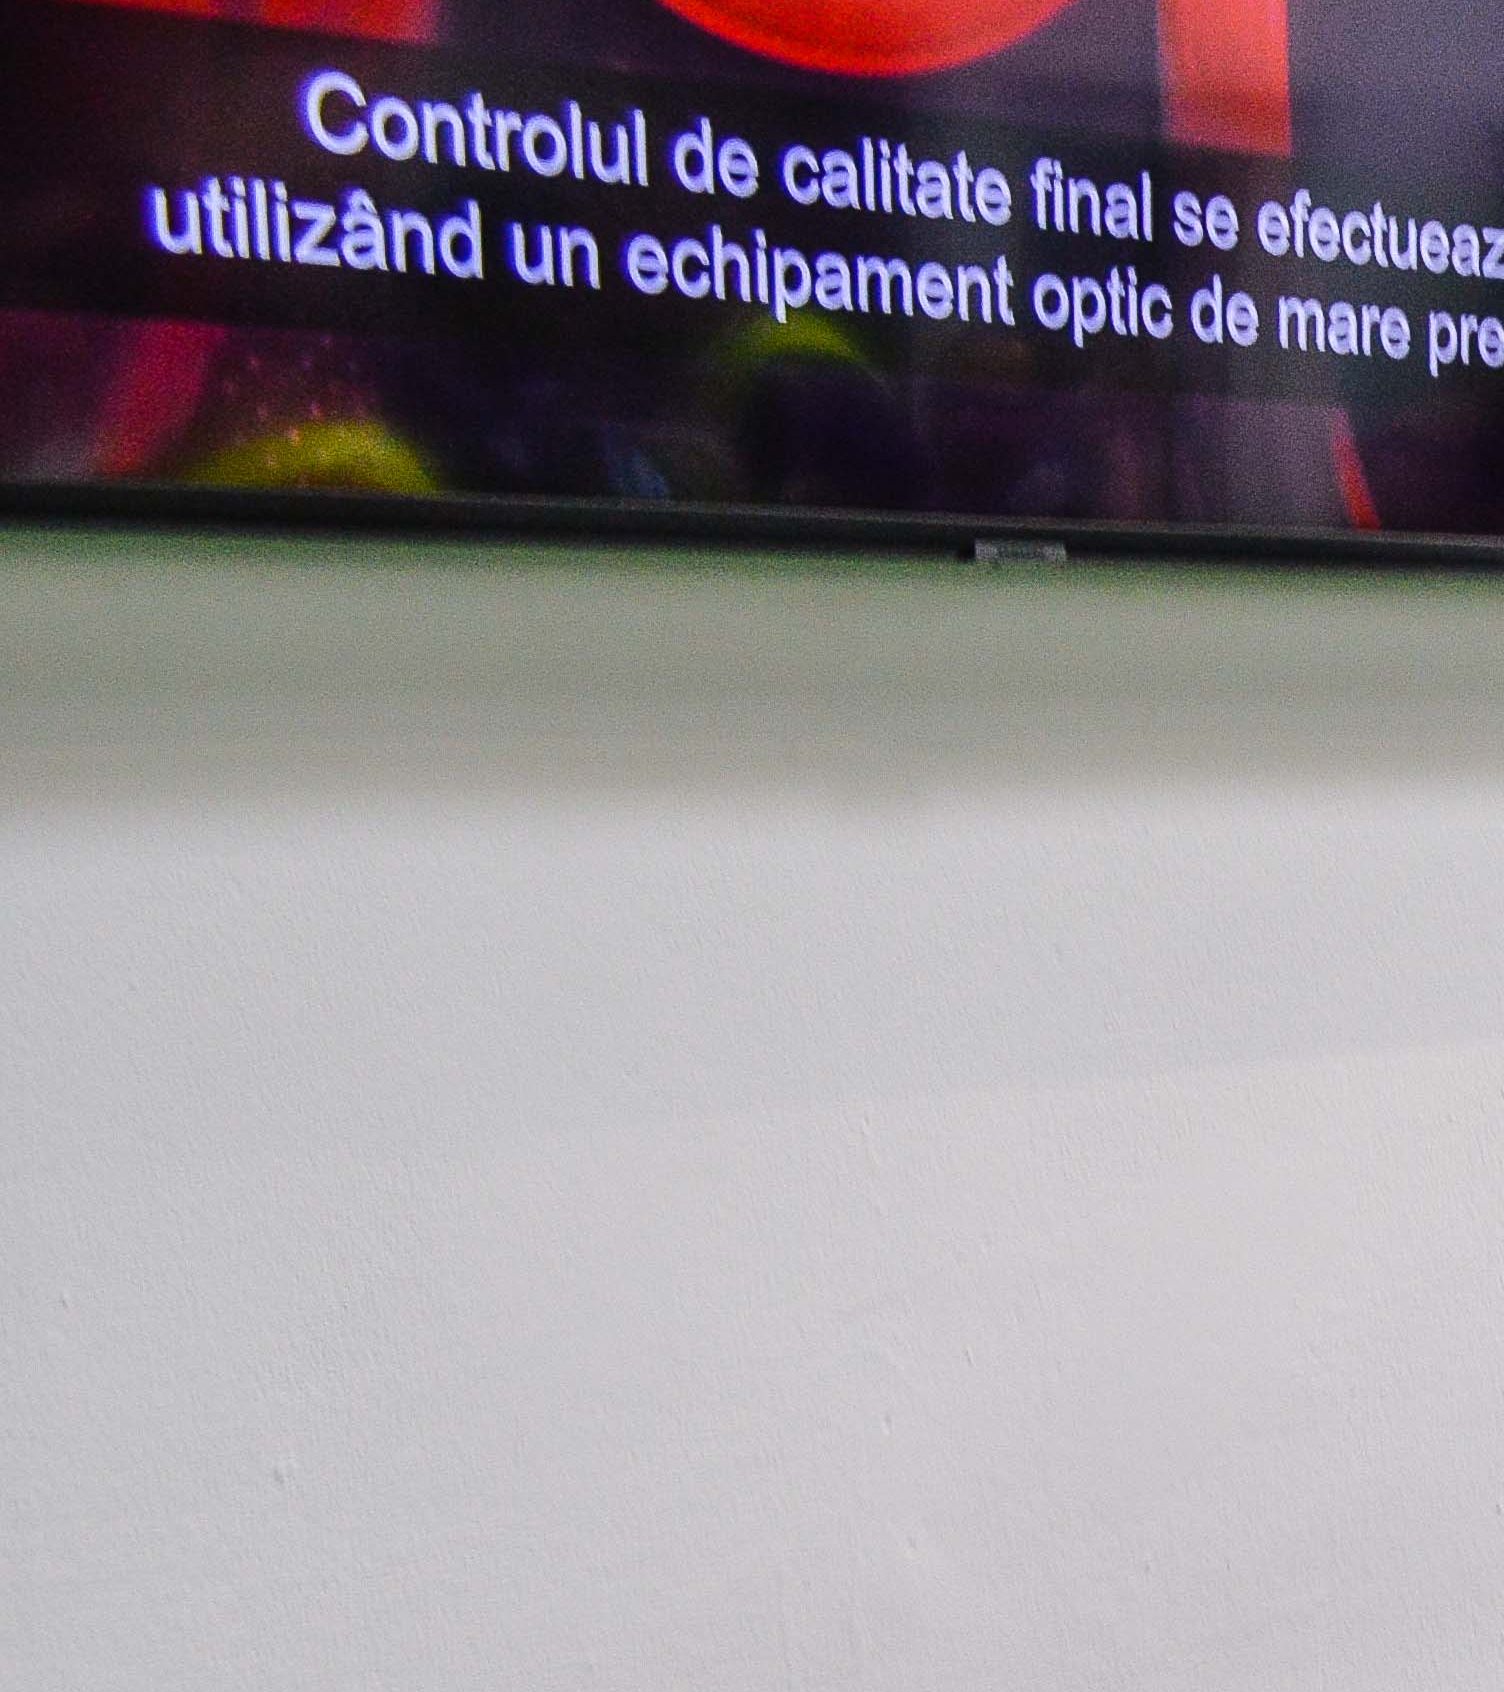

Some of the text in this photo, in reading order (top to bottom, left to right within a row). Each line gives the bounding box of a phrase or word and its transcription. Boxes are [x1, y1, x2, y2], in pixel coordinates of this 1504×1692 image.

[302, 70, 648, 187] Controlul
[673, 117, 759, 198] de
[782, 136, 1012, 226] calitate
[1030, 157, 1153, 242] final
[1172, 190, 1239, 251] se
[148, 175, 483, 279] utilizând
[510, 221, 601, 290] un
[626, 223, 1016, 327] echipament
[1031, 265, 1174, 348] optic
[1190, 274, 1259, 347] de
[1277, 295, 1411, 359] mare
